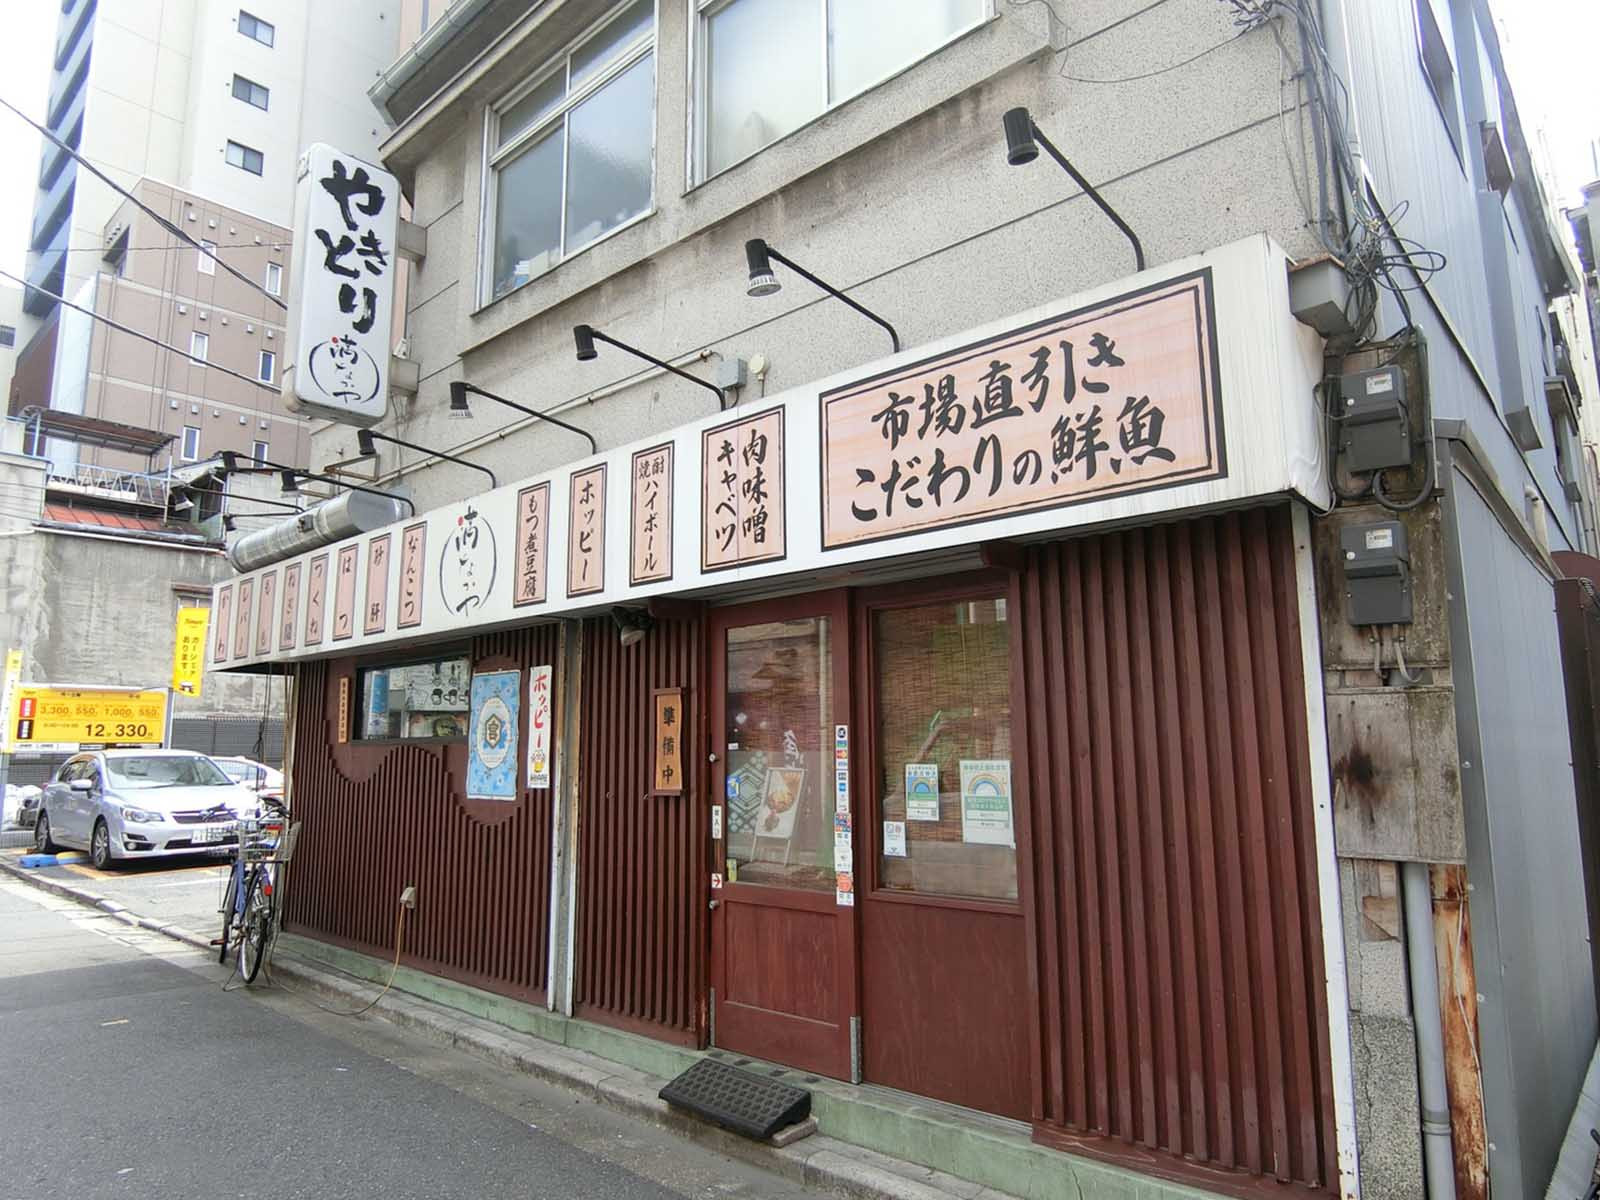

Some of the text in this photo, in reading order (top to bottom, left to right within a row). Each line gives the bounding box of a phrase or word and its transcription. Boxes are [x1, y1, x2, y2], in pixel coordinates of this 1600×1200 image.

[314, 160, 389, 334] やきとり
[871, 332, 1125, 450] 市場直引き
[715, 440, 737, 552] キャベツ
[742, 429, 768, 543] 肉味噌
[851, 395, 1176, 522] こだわりの鮮魚
[404, 535, 418, 617] なんこつ
[523, 495, 539, 597] もつ煮豆腐
[580, 481, 595, 581] ホッピー
[310, 564, 322, 635] つくね
[339, 556, 352, 631] はつ
[85, 724, 105, 737] 12
[114, 724, 148, 737] 330
[534, 674, 548, 748] ホッピー
[662, 705, 676, 785] 準備中
